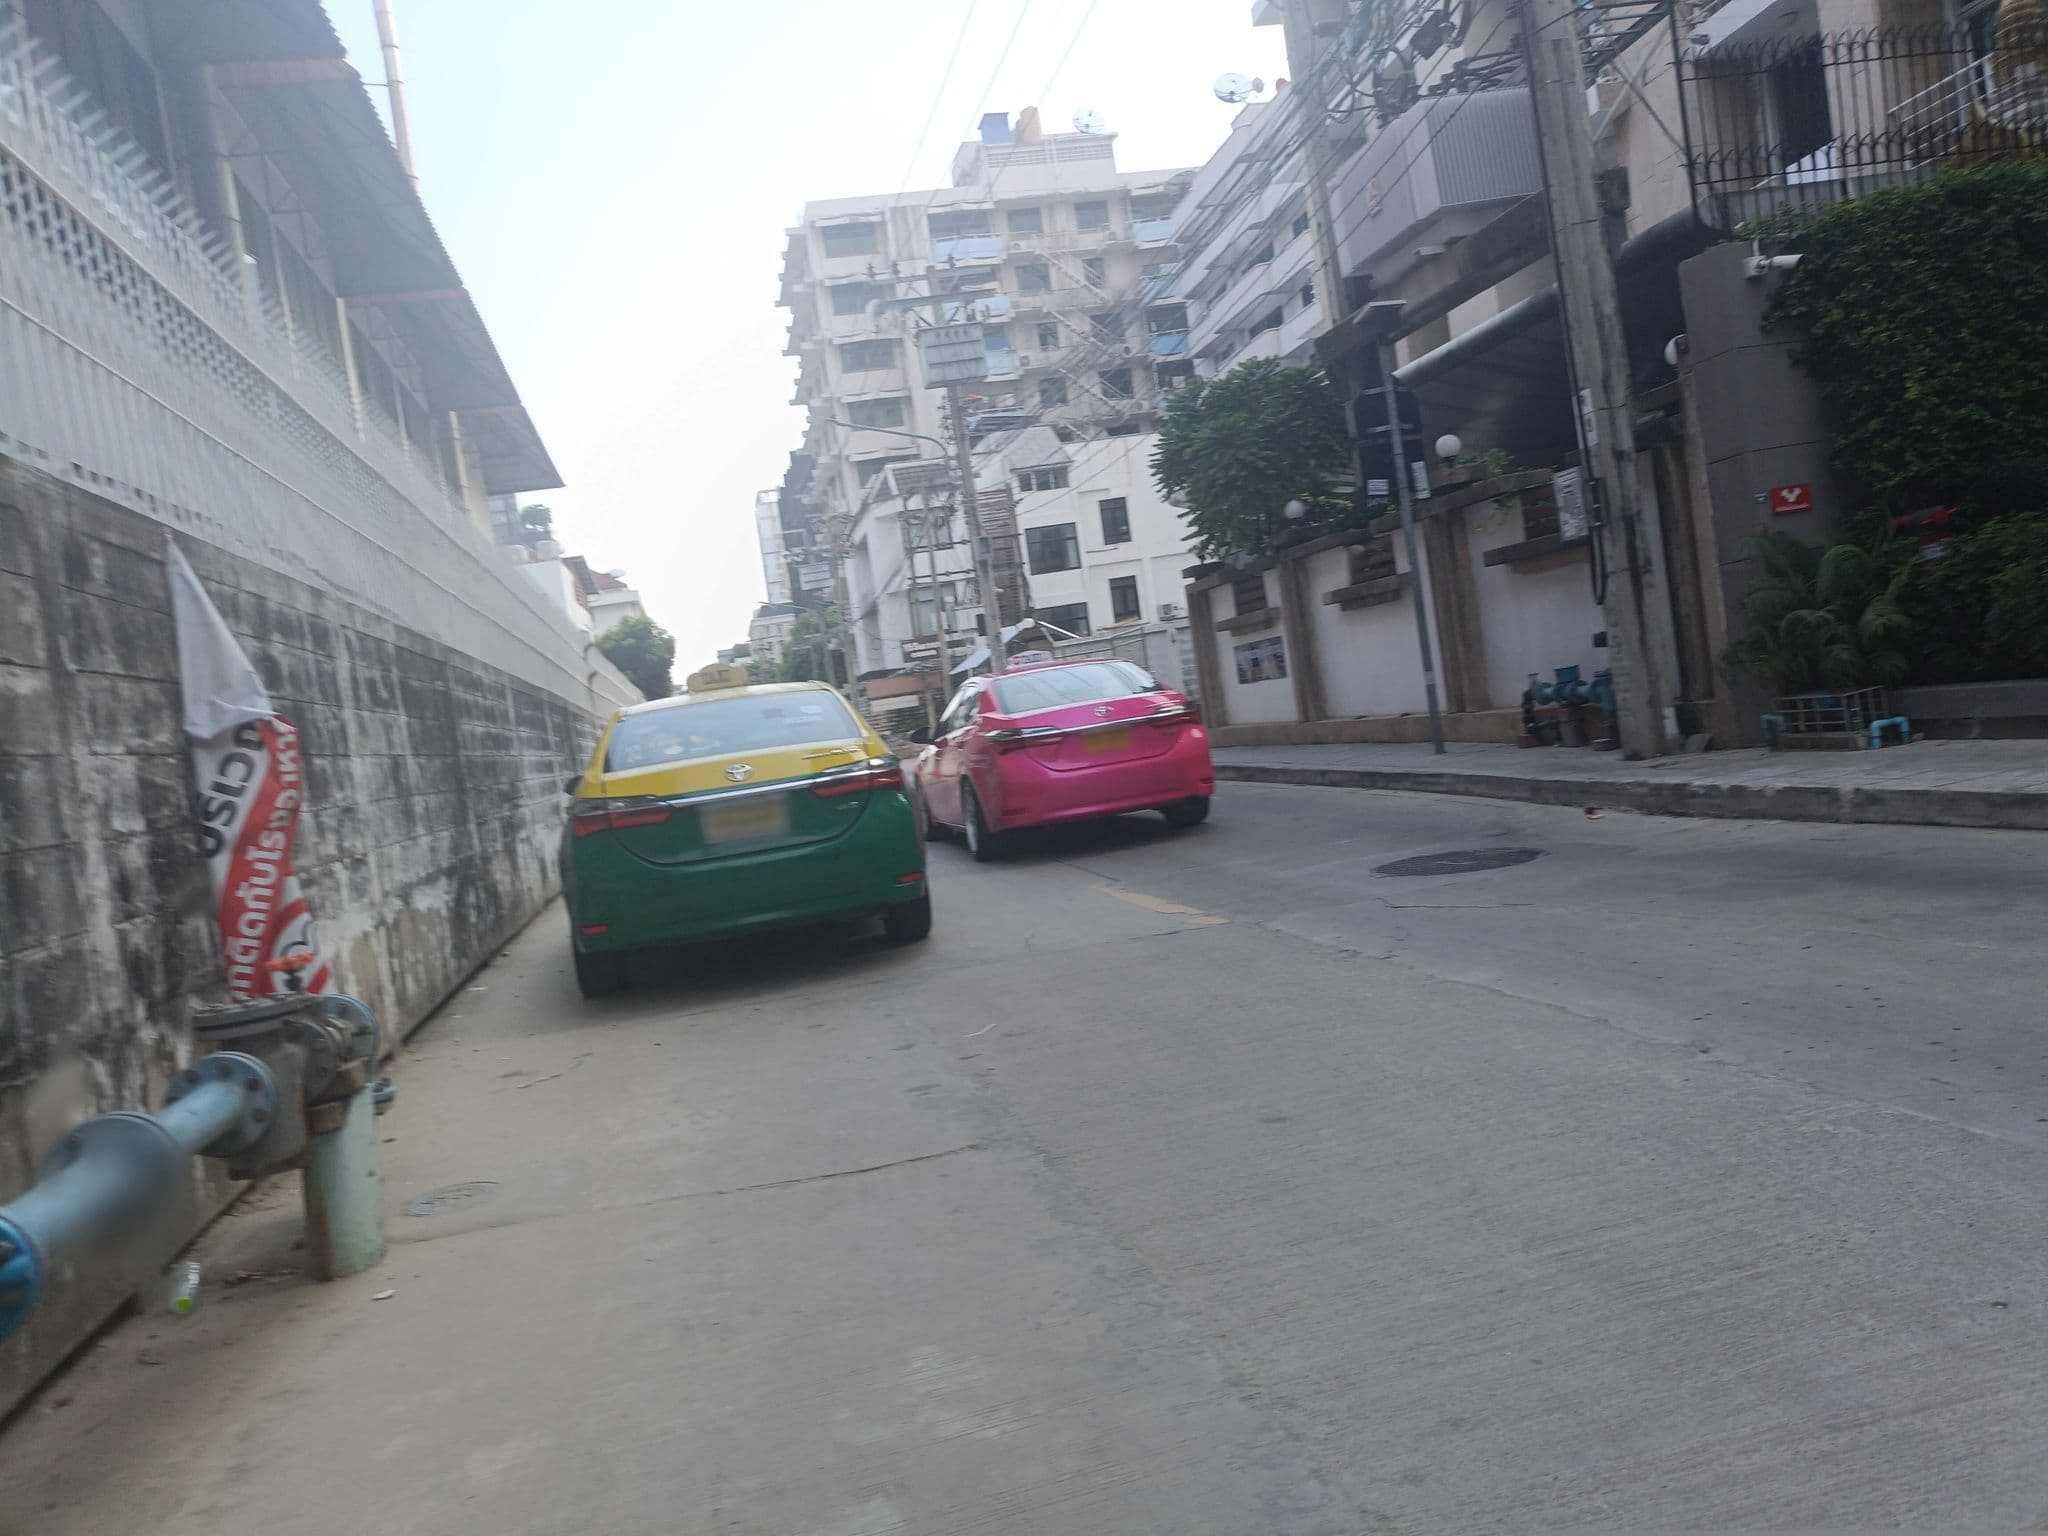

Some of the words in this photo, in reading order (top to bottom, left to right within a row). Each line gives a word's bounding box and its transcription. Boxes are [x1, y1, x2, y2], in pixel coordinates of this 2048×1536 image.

[226, 718, 300, 1003] กติดกับโรงอาหา
